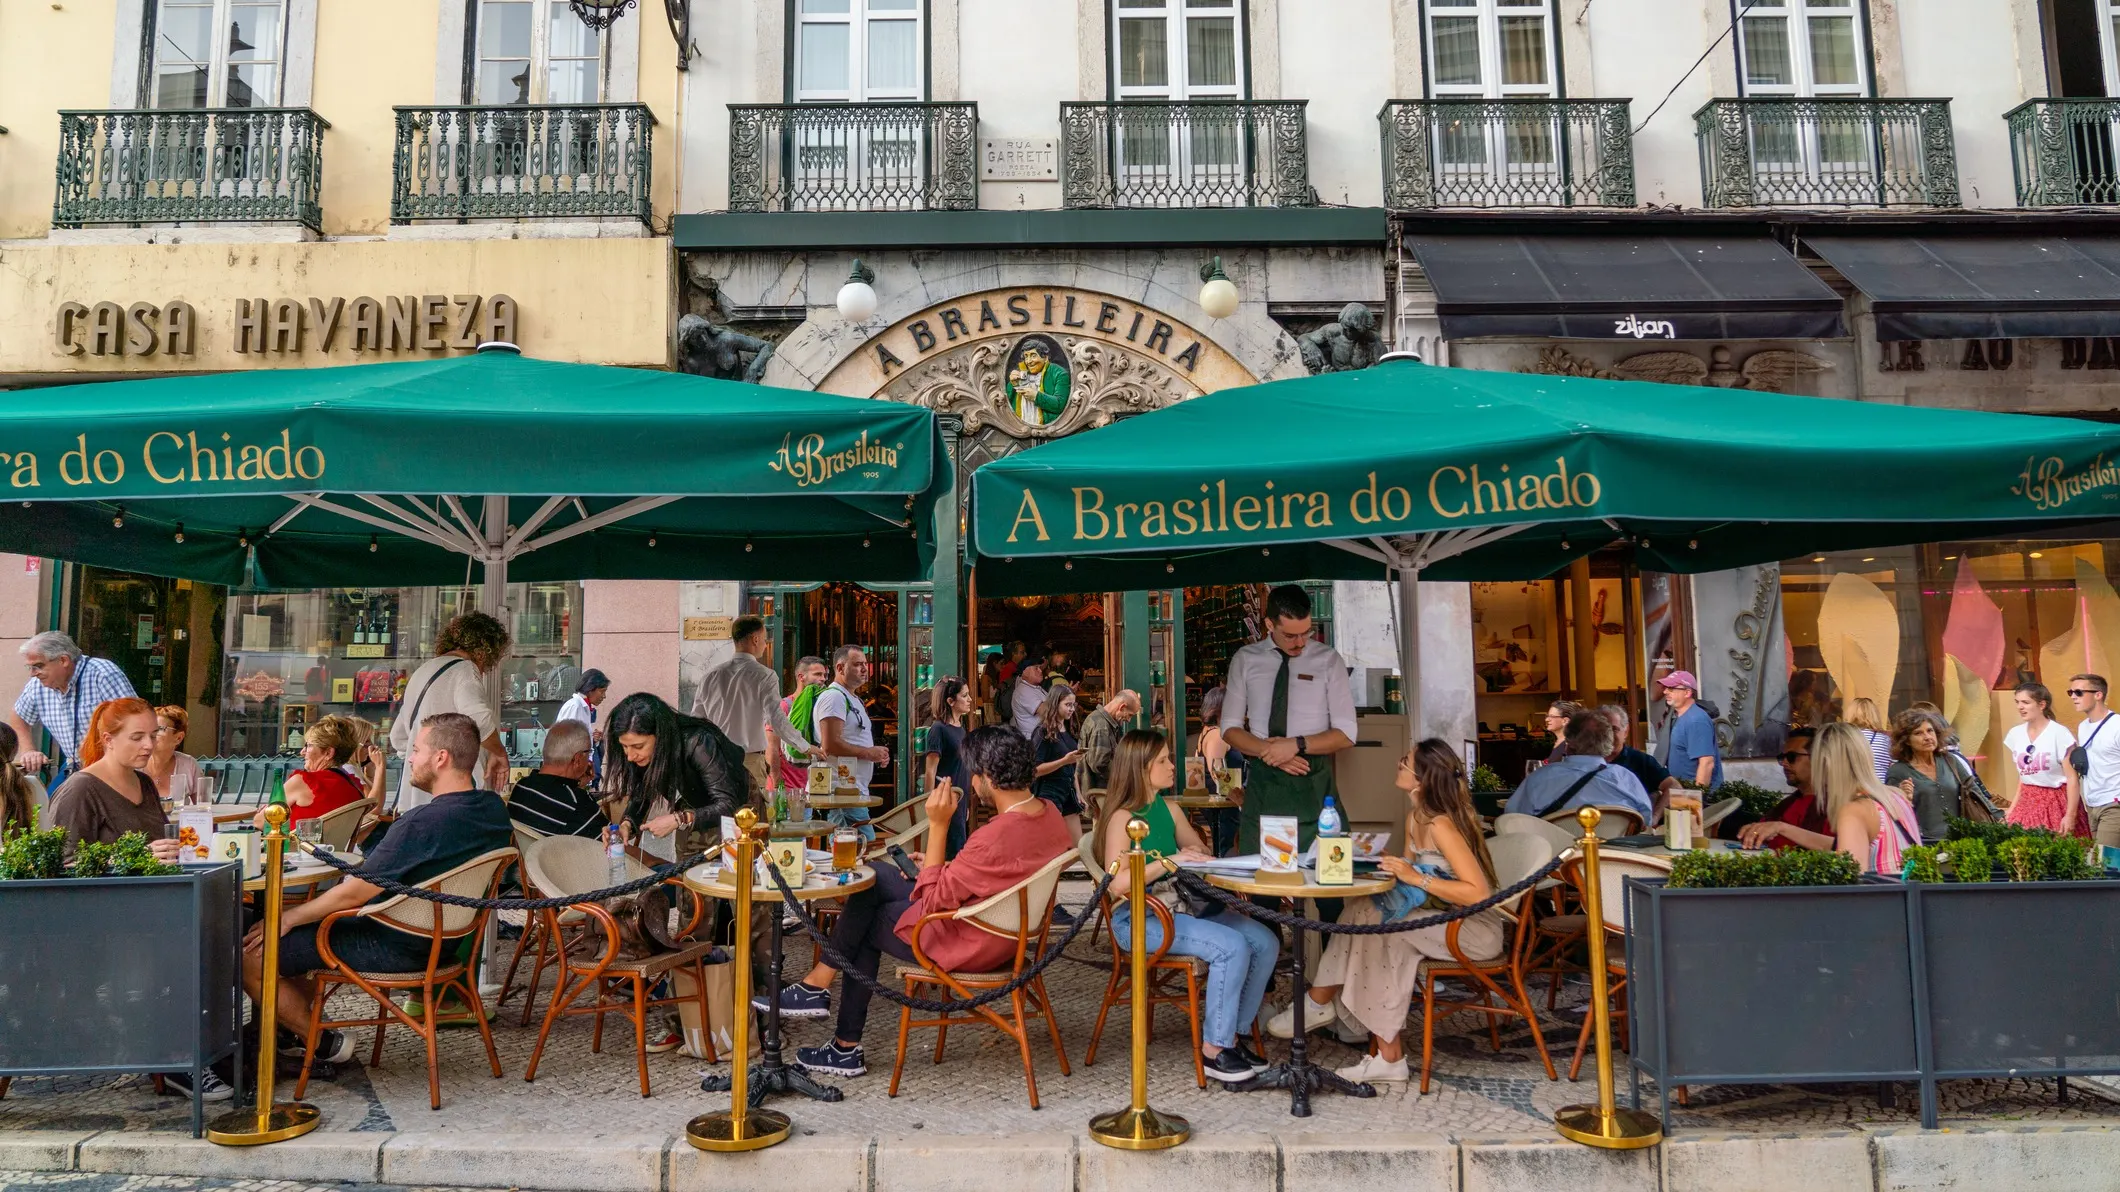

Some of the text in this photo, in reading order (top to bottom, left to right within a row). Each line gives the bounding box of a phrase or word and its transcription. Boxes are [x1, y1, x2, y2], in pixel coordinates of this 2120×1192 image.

[988, 151, 1052, 163] GARRETT
[1006, 141, 1032, 149] RUA
[55, 294, 518, 356] CASA HAVANEZA
[875, 294, 1201, 374] A BRASILEIRA
[1614, 313, 1676, 339] zilian
[59, 432, 125, 486] do
[143, 427, 326, 484] Chiado
[768, 431, 806, 478] A
[862, 471, 880, 479] 1905
[1005, 456, 1601, 543] A Brasileira do Chiado
